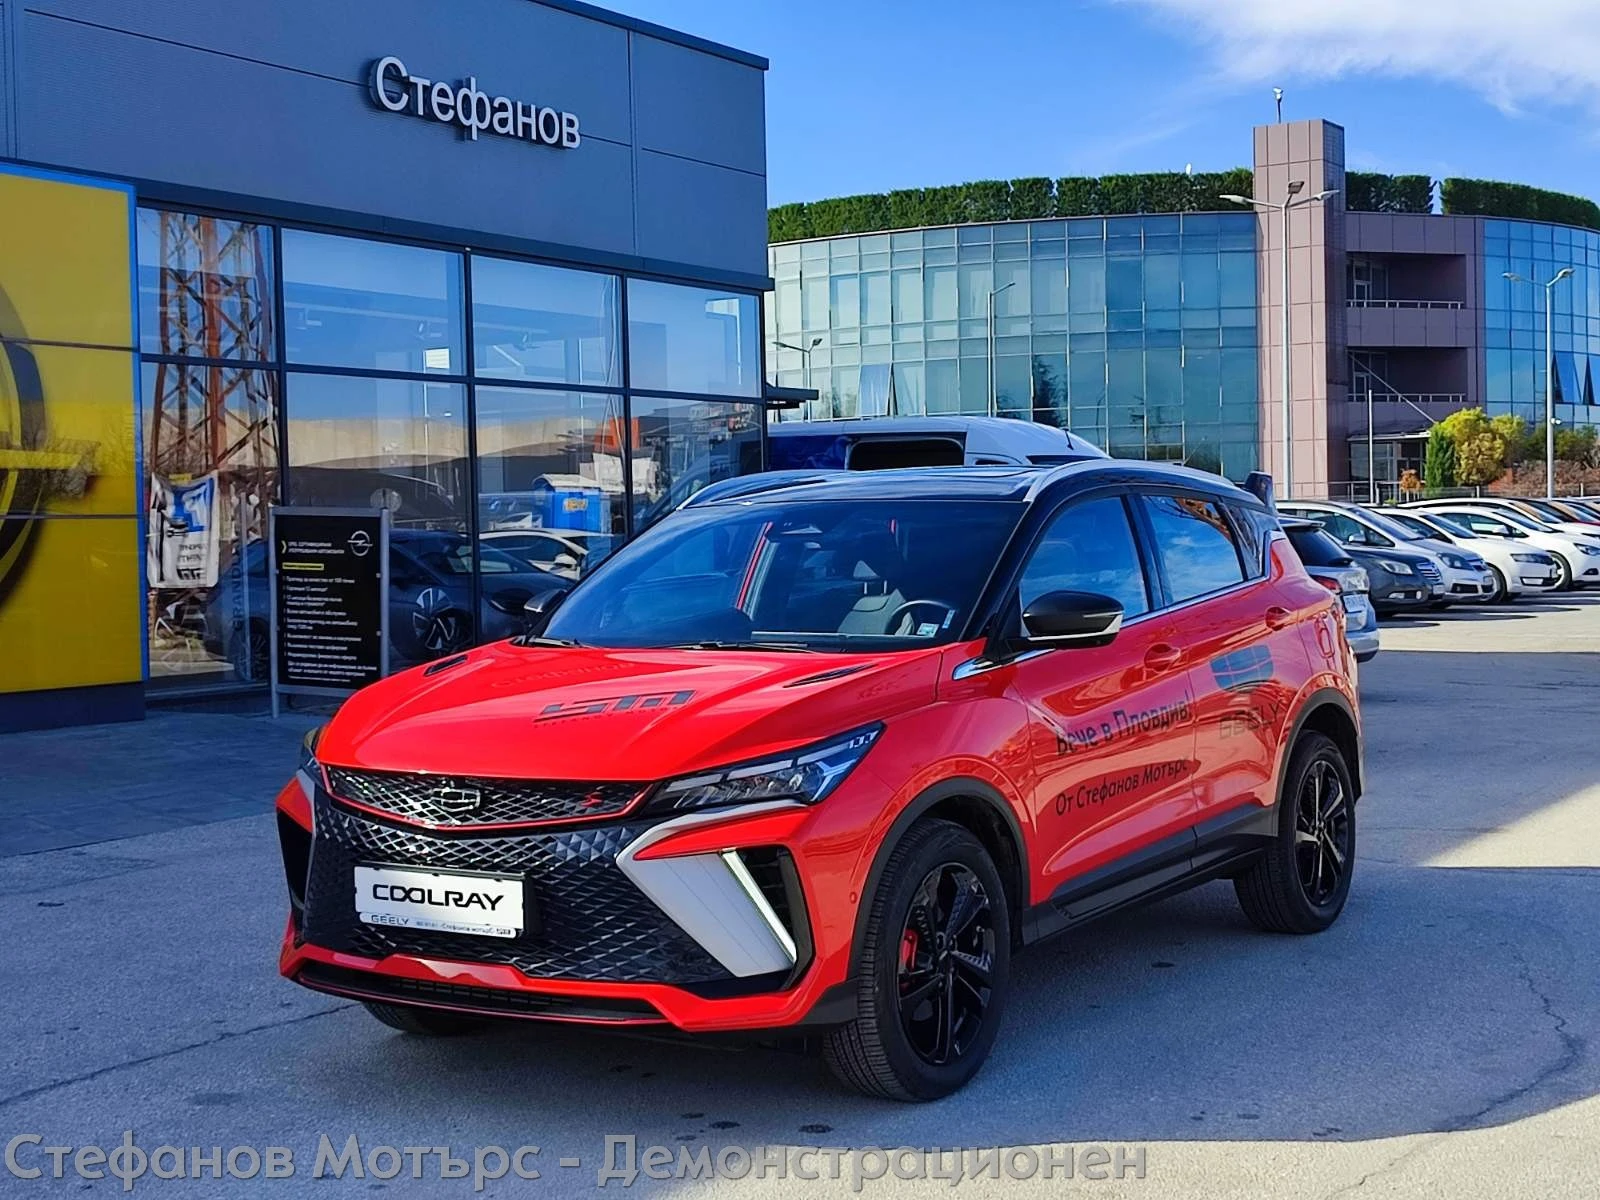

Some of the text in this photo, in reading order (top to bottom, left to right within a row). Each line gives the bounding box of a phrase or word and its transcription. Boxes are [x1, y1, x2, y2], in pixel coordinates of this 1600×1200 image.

[374, 55, 581, 149] Стефанов
[1056, 725, 1099, 756] Вече
[1100, 722, 1114, 742] в
[1055, 759, 1188, 816] От Стефанов Мотърс
[372, 883, 505, 912] COOLRAY
[371, 914, 410, 927] GEELY
